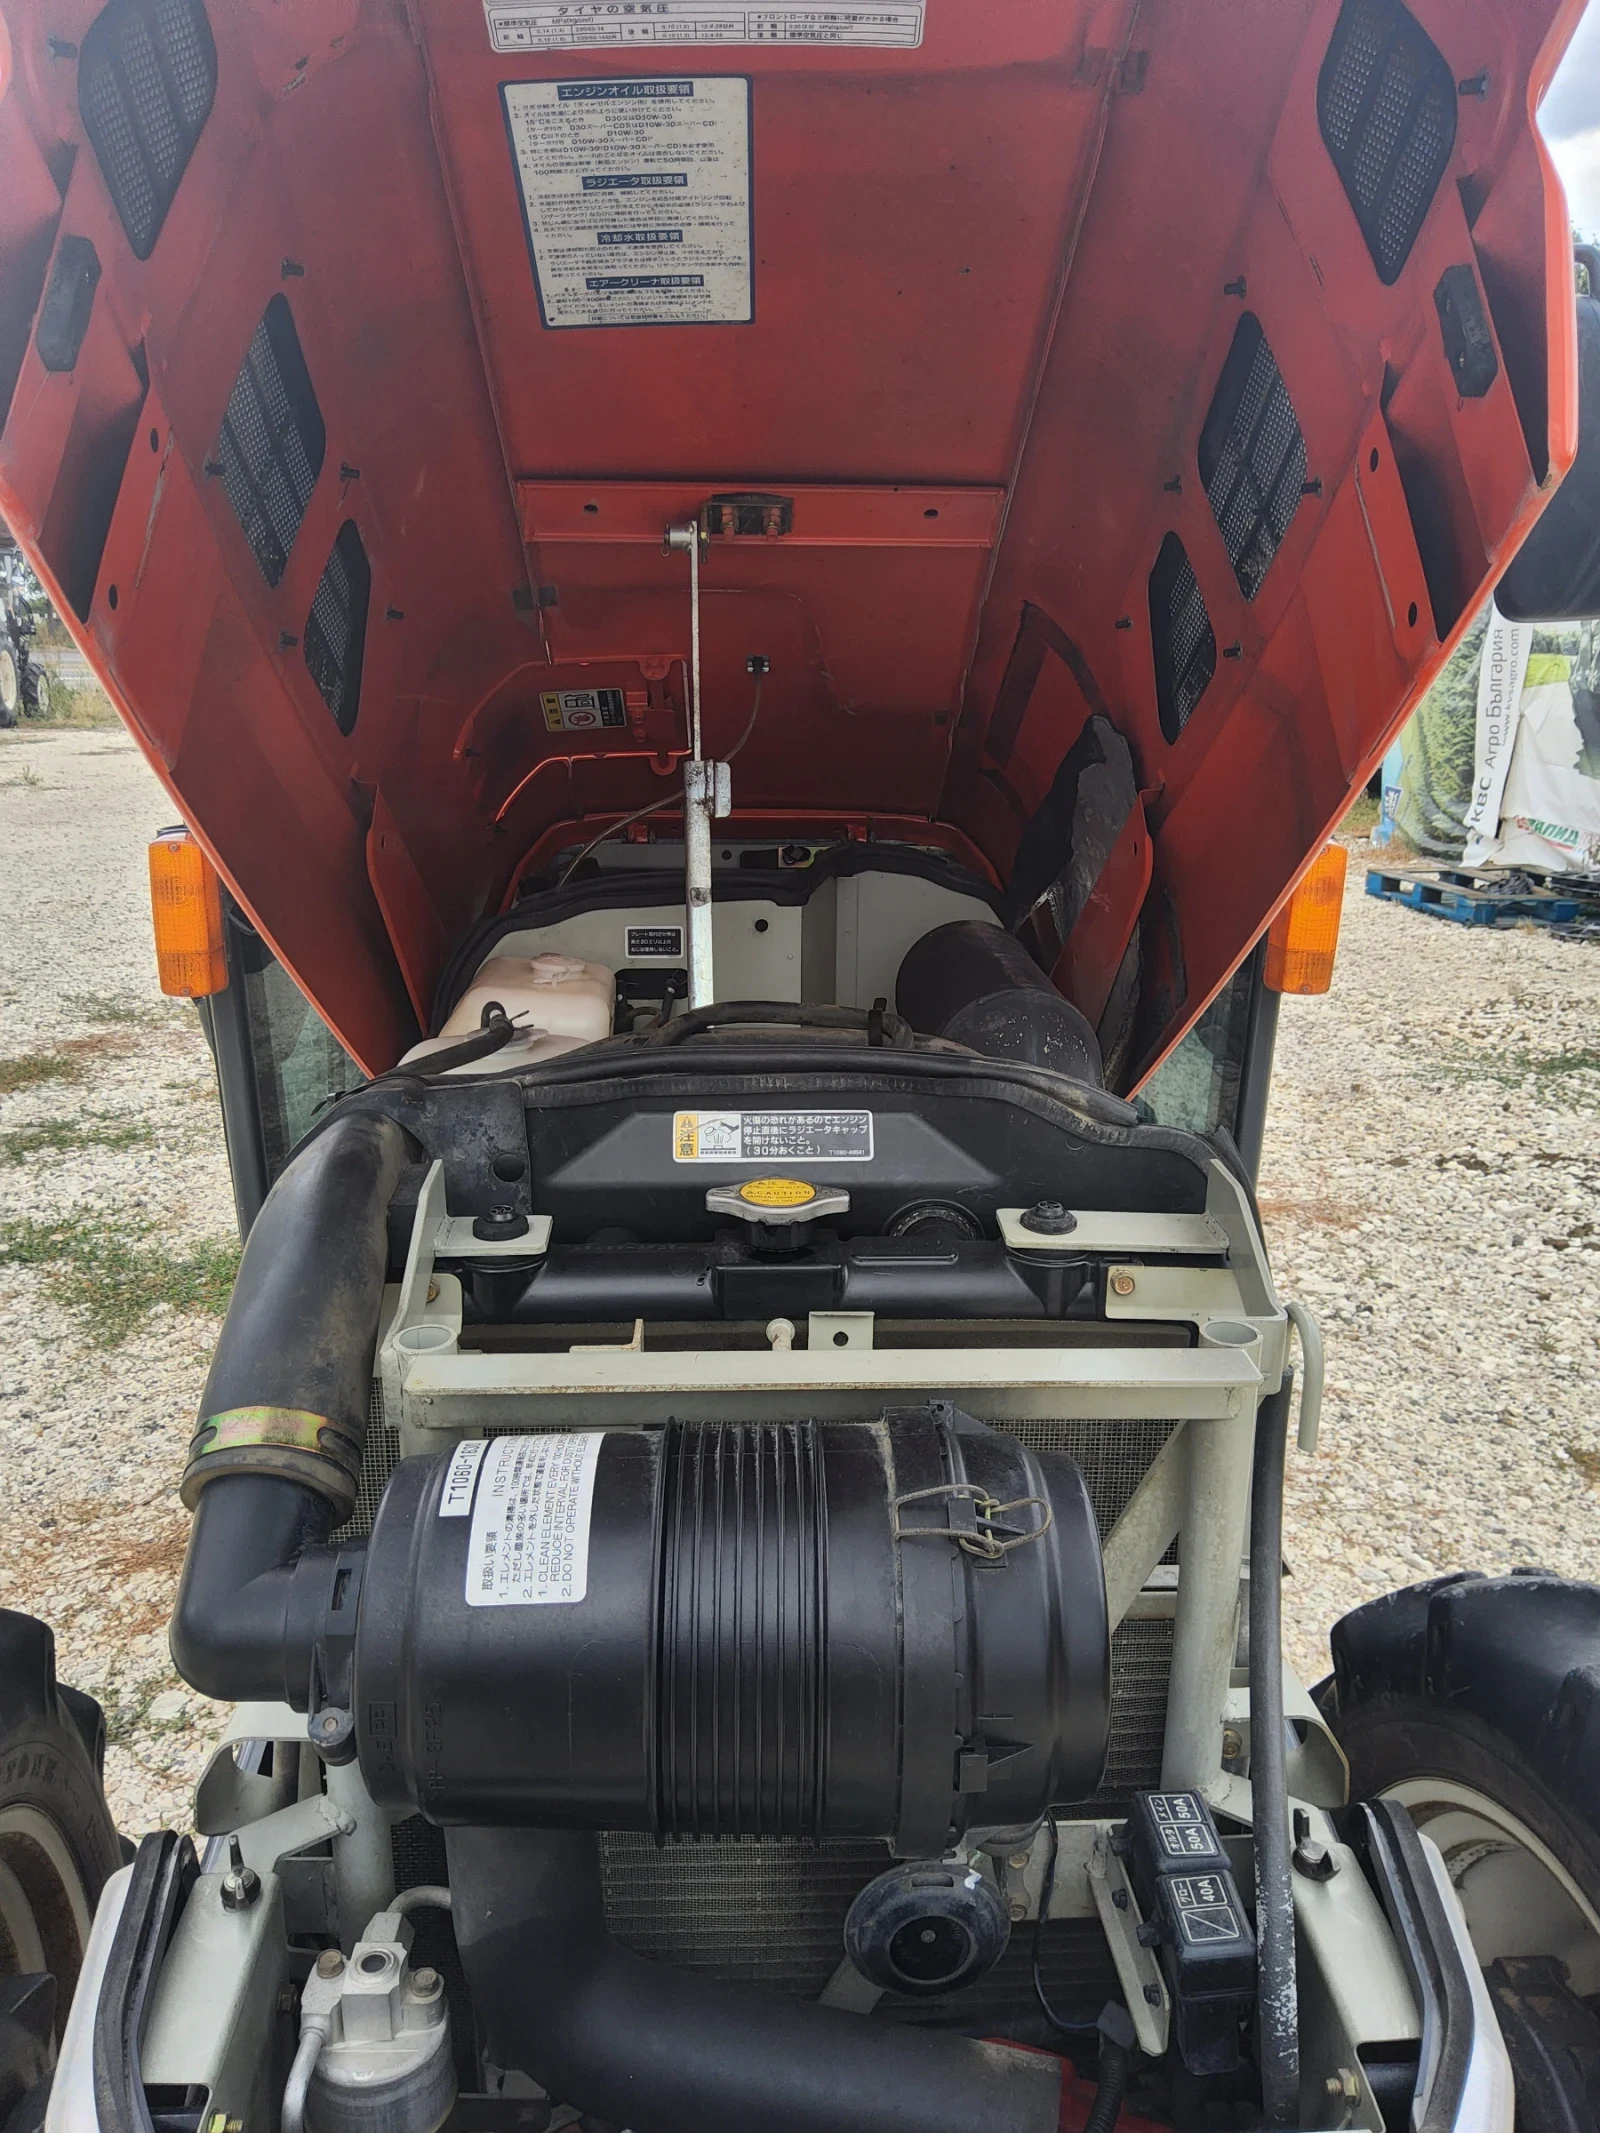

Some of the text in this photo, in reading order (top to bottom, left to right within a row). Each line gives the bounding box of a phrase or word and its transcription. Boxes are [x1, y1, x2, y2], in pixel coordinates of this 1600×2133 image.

[558, 4, 669, 16] タイヤの空気圧
[562, 85, 690, 98] エンジンオイル取扱要領
[586, 176, 684, 187] ラジエータ取扱要領
[601, 232, 680, 242] 冷却水取扱要領
[590, 276, 701, 288] エアークリーナ取扱要領
[1471, 629, 1507, 822] КВС Агро България
[744, 1116, 868, 1125] 火傷の恐れがあるのでエンジン
[744, 1126, 868, 1135] 停止直後にラジエータキャップ
[679, 1130, 694, 1156] 注意
[744, 1136, 810, 1146] を開けないこと。
[547, 1462, 560, 1488] EVERY
[560, 1464, 570, 1482] FOR
[571, 1454, 584, 1484] WITHOUT
[542, 1492, 555, 1538] ELEMENT
[554, 1482, 568, 1530] INTERVAL
[566, 1486, 580, 1532] OPERATE
[550, 1534, 562, 1582] REDUCE
[564, 1535, 574, 1560] NOT
[482, 1530, 498, 1590] 取扱い要領
[539, 1542, 550, 1582] CLEAN
[563, 1564, 572, 1582] DO
[1154, 1798, 1168, 1818] メイン
[1173, 1798, 1192, 1819] 50A
[1165, 1828, 1180, 1850] オルタ
[1185, 1828, 1204, 1850] 50A
[1178, 1883, 1192, 1903] グロー
[1198, 1880, 1216, 1902] 40A
